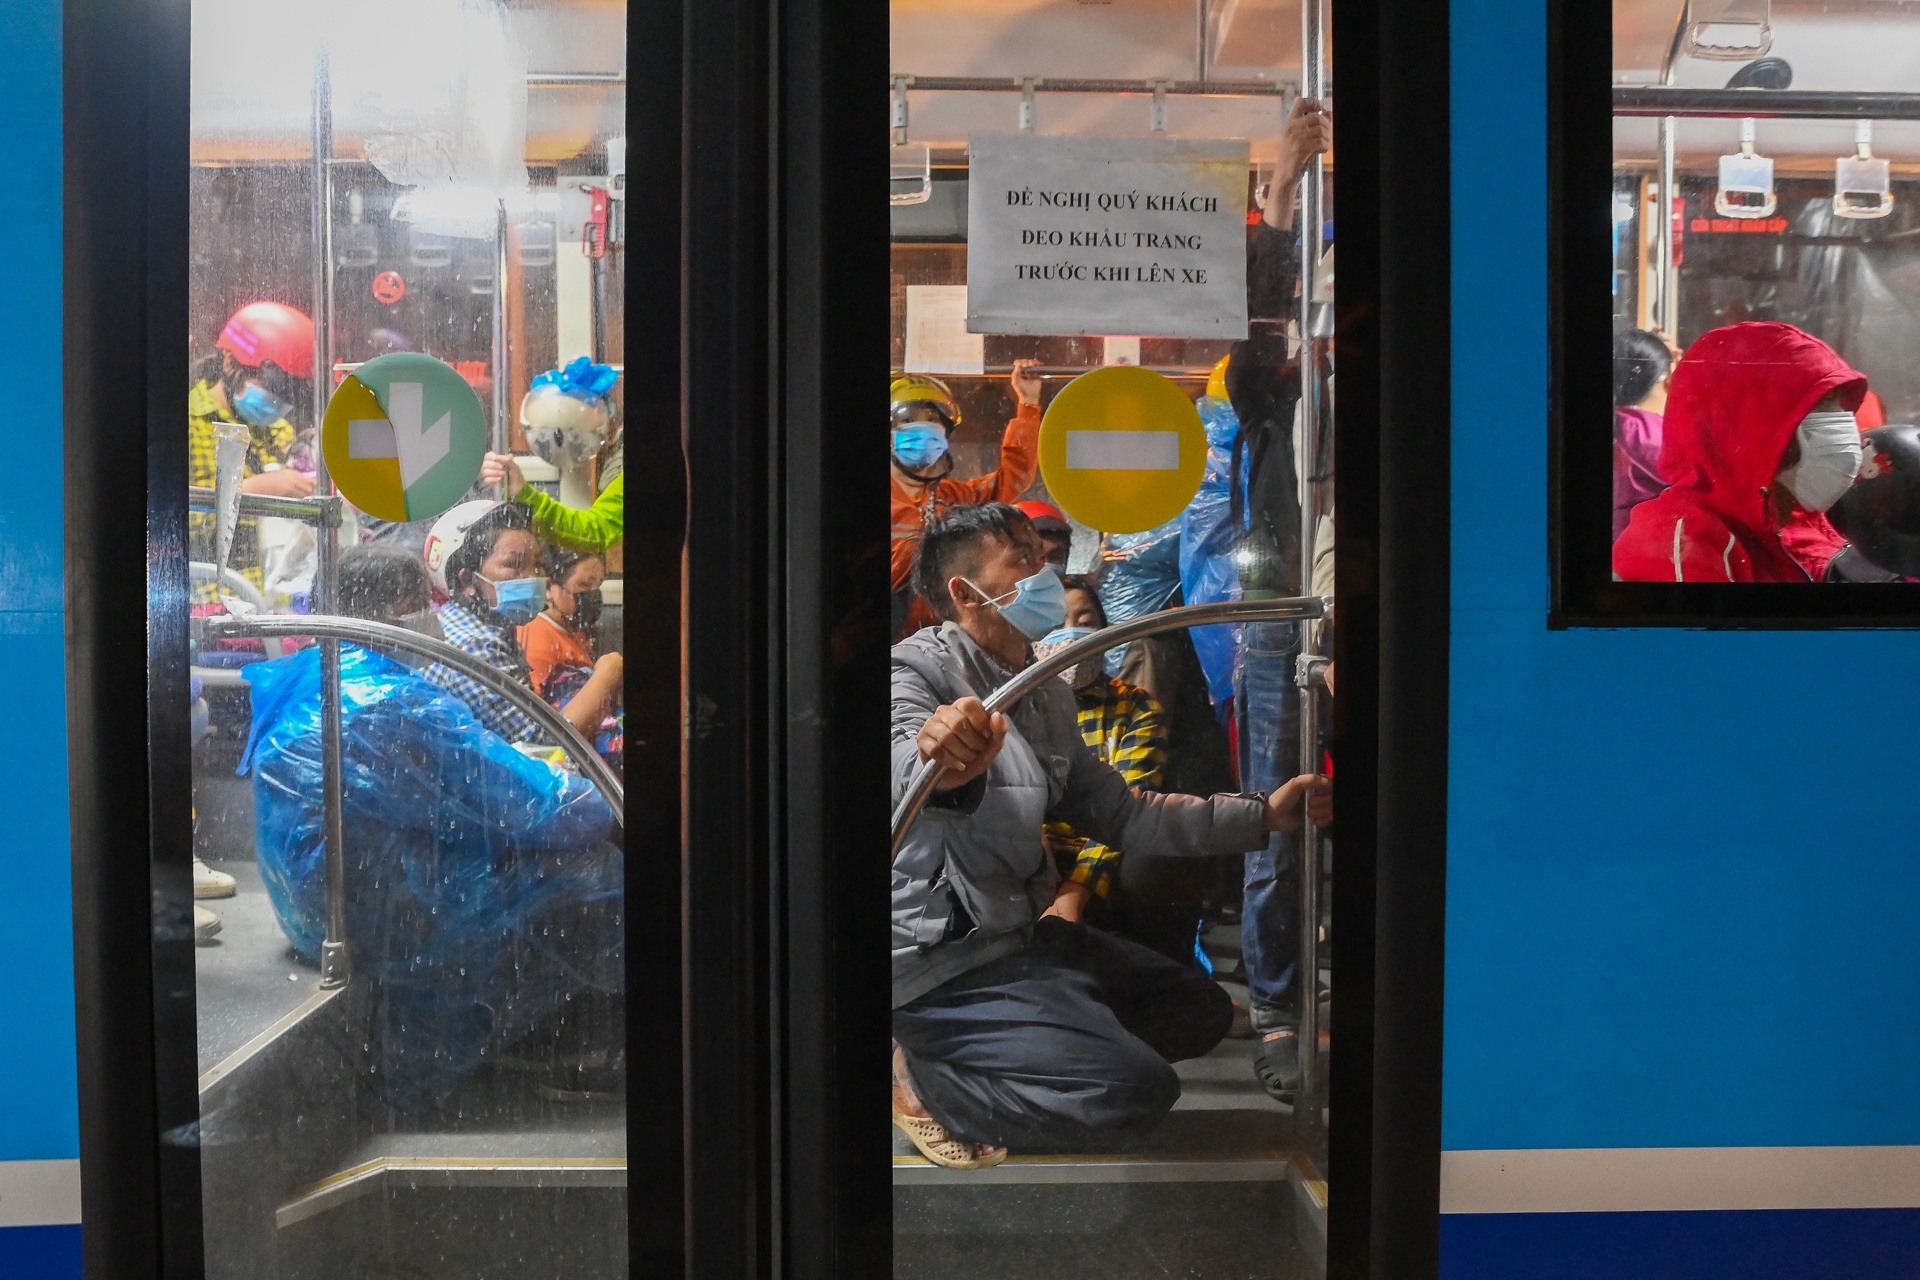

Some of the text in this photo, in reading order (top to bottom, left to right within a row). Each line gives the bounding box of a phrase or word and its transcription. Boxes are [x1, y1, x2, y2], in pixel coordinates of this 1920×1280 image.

[1039, 191, 1090, 212] NGHỊ
[1097, 189, 1140, 213] QUÝ
[1145, 191, 1218, 212] KHÁCH
[1021, 229, 1063, 246] ĐEO
[1132, 232, 1202, 250] TRANG
[1014, 261, 1207, 284] TRƯỚC KHI LÊN XE
